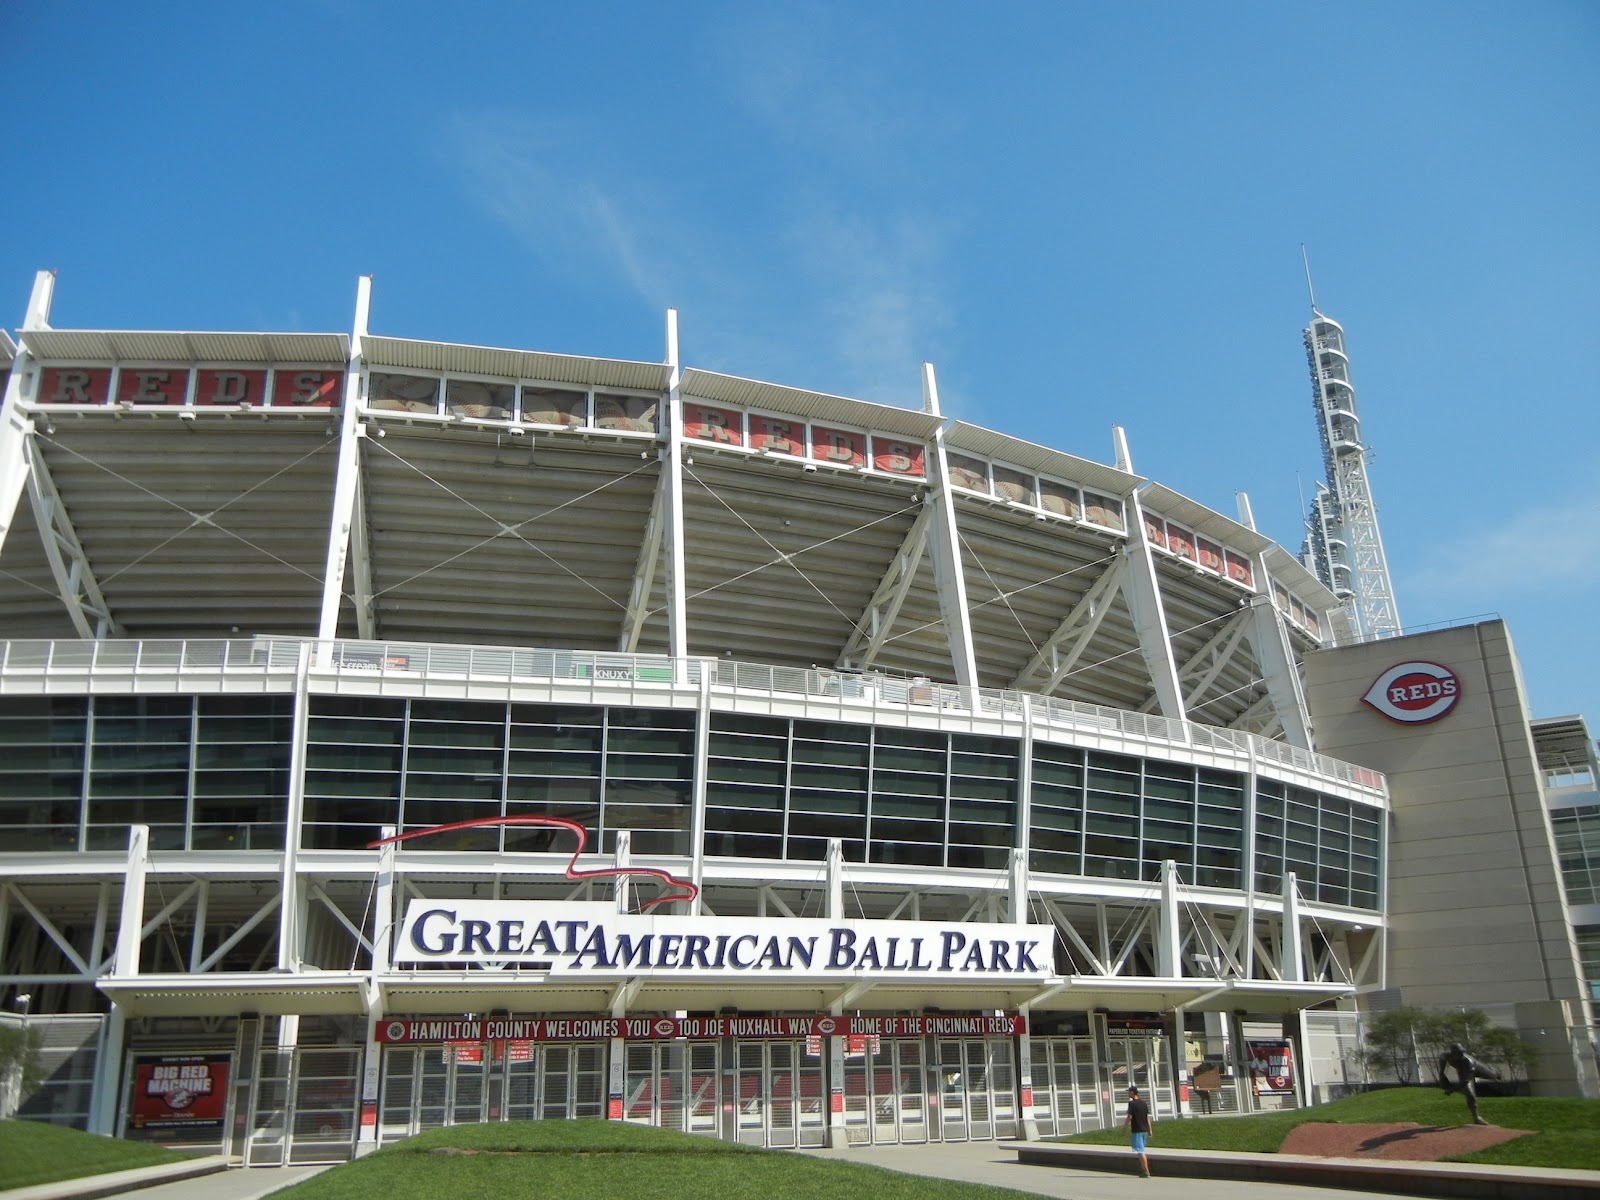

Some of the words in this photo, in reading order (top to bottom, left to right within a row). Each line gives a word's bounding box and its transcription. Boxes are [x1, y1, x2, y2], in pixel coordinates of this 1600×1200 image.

[50, 370, 328, 404] REDS
[696, 407, 915, 472] REDS
[594, 669, 641, 680] KNUXY'S
[1390, 679, 1457, 703] REDS
[410, 908, 589, 957] GREAT
[567, 924, 819, 970] AMERICAN
[823, 928, 933, 972] BALL
[936, 930, 1040, 973] PARK
[409, 1021, 481, 1040] HAMILTON
[487, 1020, 540, 1038] COUNTY
[546, 1019, 619, 1038] WELCOMES
[625, 1019, 650, 1037] YOU
[677, 1019, 700, 1036] 100
[703, 1019, 724, 1036] JOE
[729, 1018, 785, 1036] NUXHALL
[788, 1018, 814, 1035] WAY
[850, 1018, 883, 1035] HOME
[885, 1018, 899, 1035] OF
[902, 1017, 922, 1034] THE
[926, 1017, 985, 1034] CINCINNATI
[988, 1016, 1015, 1034] REDS
[154, 1066, 179, 1079] BIG
[181, 1065, 209, 1079] RED
[147, 1078, 212, 1093] MACHINE
